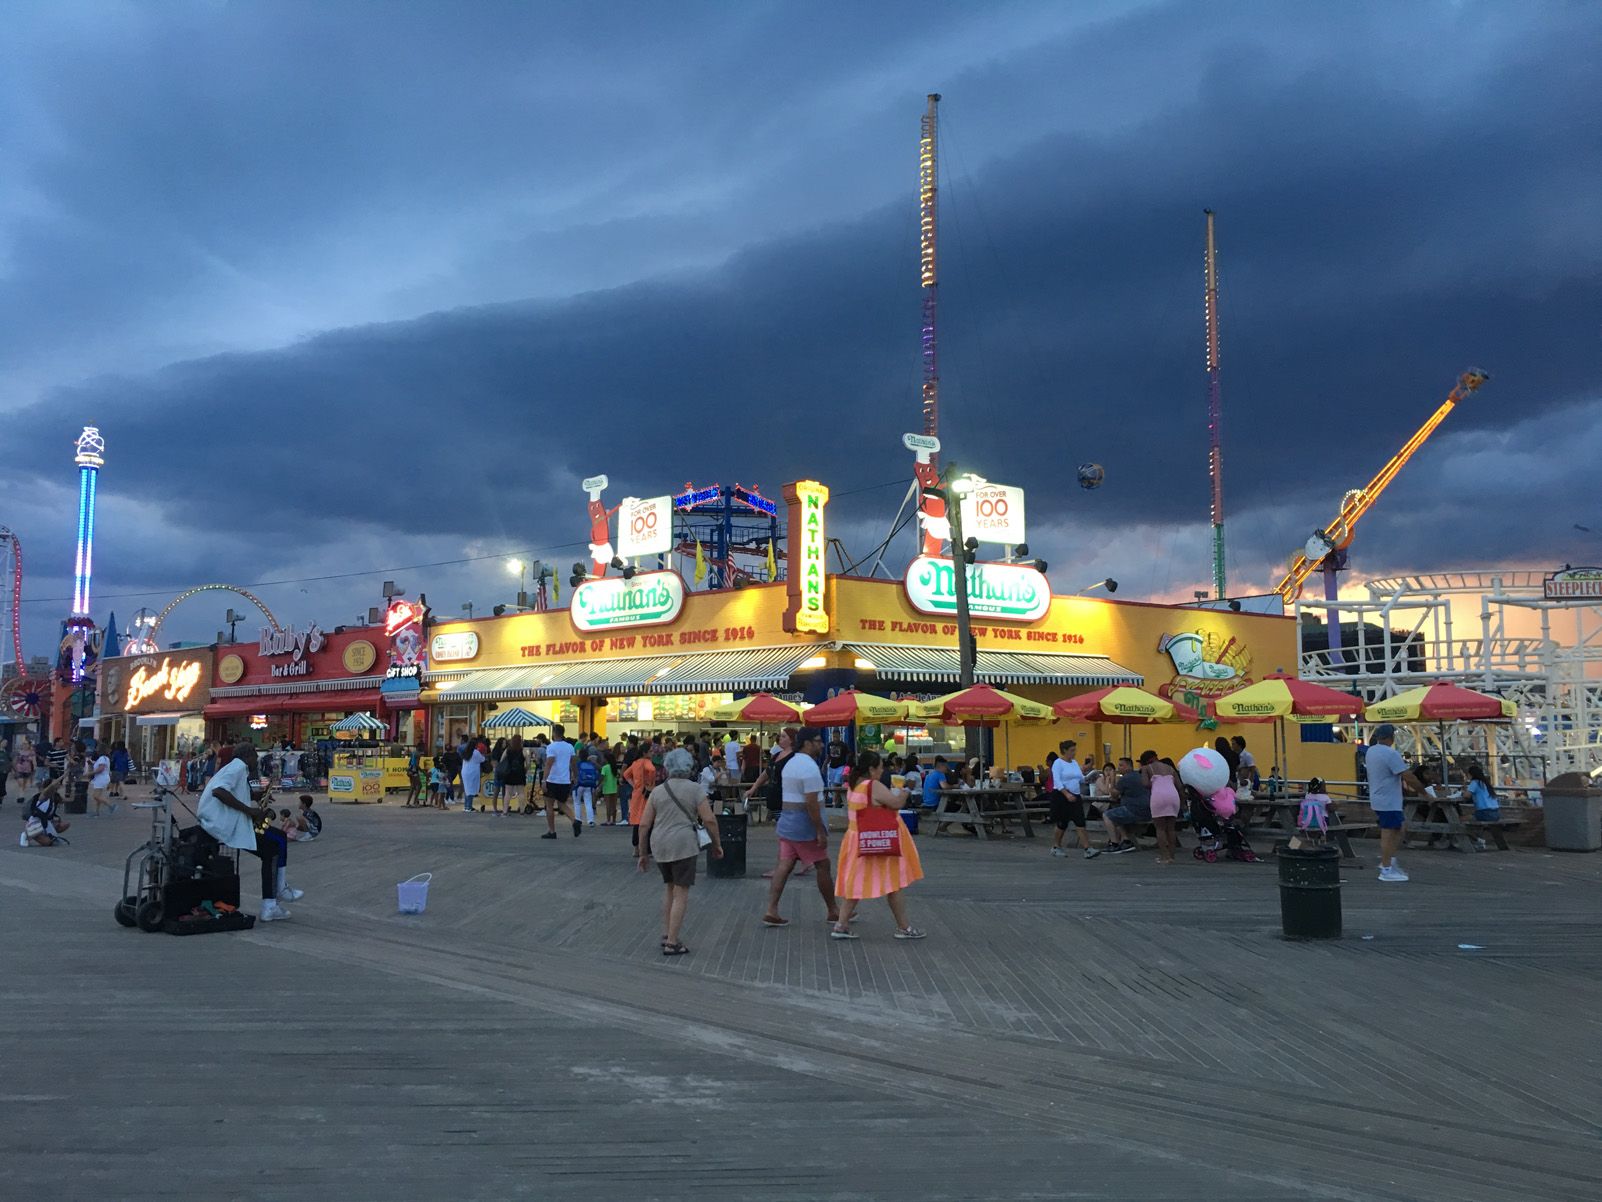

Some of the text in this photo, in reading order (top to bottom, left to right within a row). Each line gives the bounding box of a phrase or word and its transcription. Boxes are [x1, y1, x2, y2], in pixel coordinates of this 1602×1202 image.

[990, 490, 1007, 498] OVER
[631, 503, 657, 518] FOR OVER
[976, 498, 1009, 517] 100
[631, 511, 657, 536] 100
[976, 518, 1009, 528] YEARS
[630, 529, 658, 545] YEARS
[807, 495, 819, 612] NATHANS
[919, 561, 1036, 604] Nthan's
[967, 605, 1001, 613] AMOUS
[609, 614, 641, 624] FAMOUS
[859, 618, 1085, 644] THE FLAVOR OF EW YORK SINCE 1916
[257, 620, 324, 661] Ruby's
[520, 625, 755, 658] THE FLAVOR OF NEW YORK SINCE 1916
[271, 664, 283, 677] Bar
[289, 660, 307, 676] Grill
[386, 666, 418, 678] GIFT SHOP
[1114, 703, 1157, 713] Nathan's
[1232, 702, 1275, 713] Nathan's
[362, 783, 381, 792] 100
[859, 838, 891, 848] IS POWER
